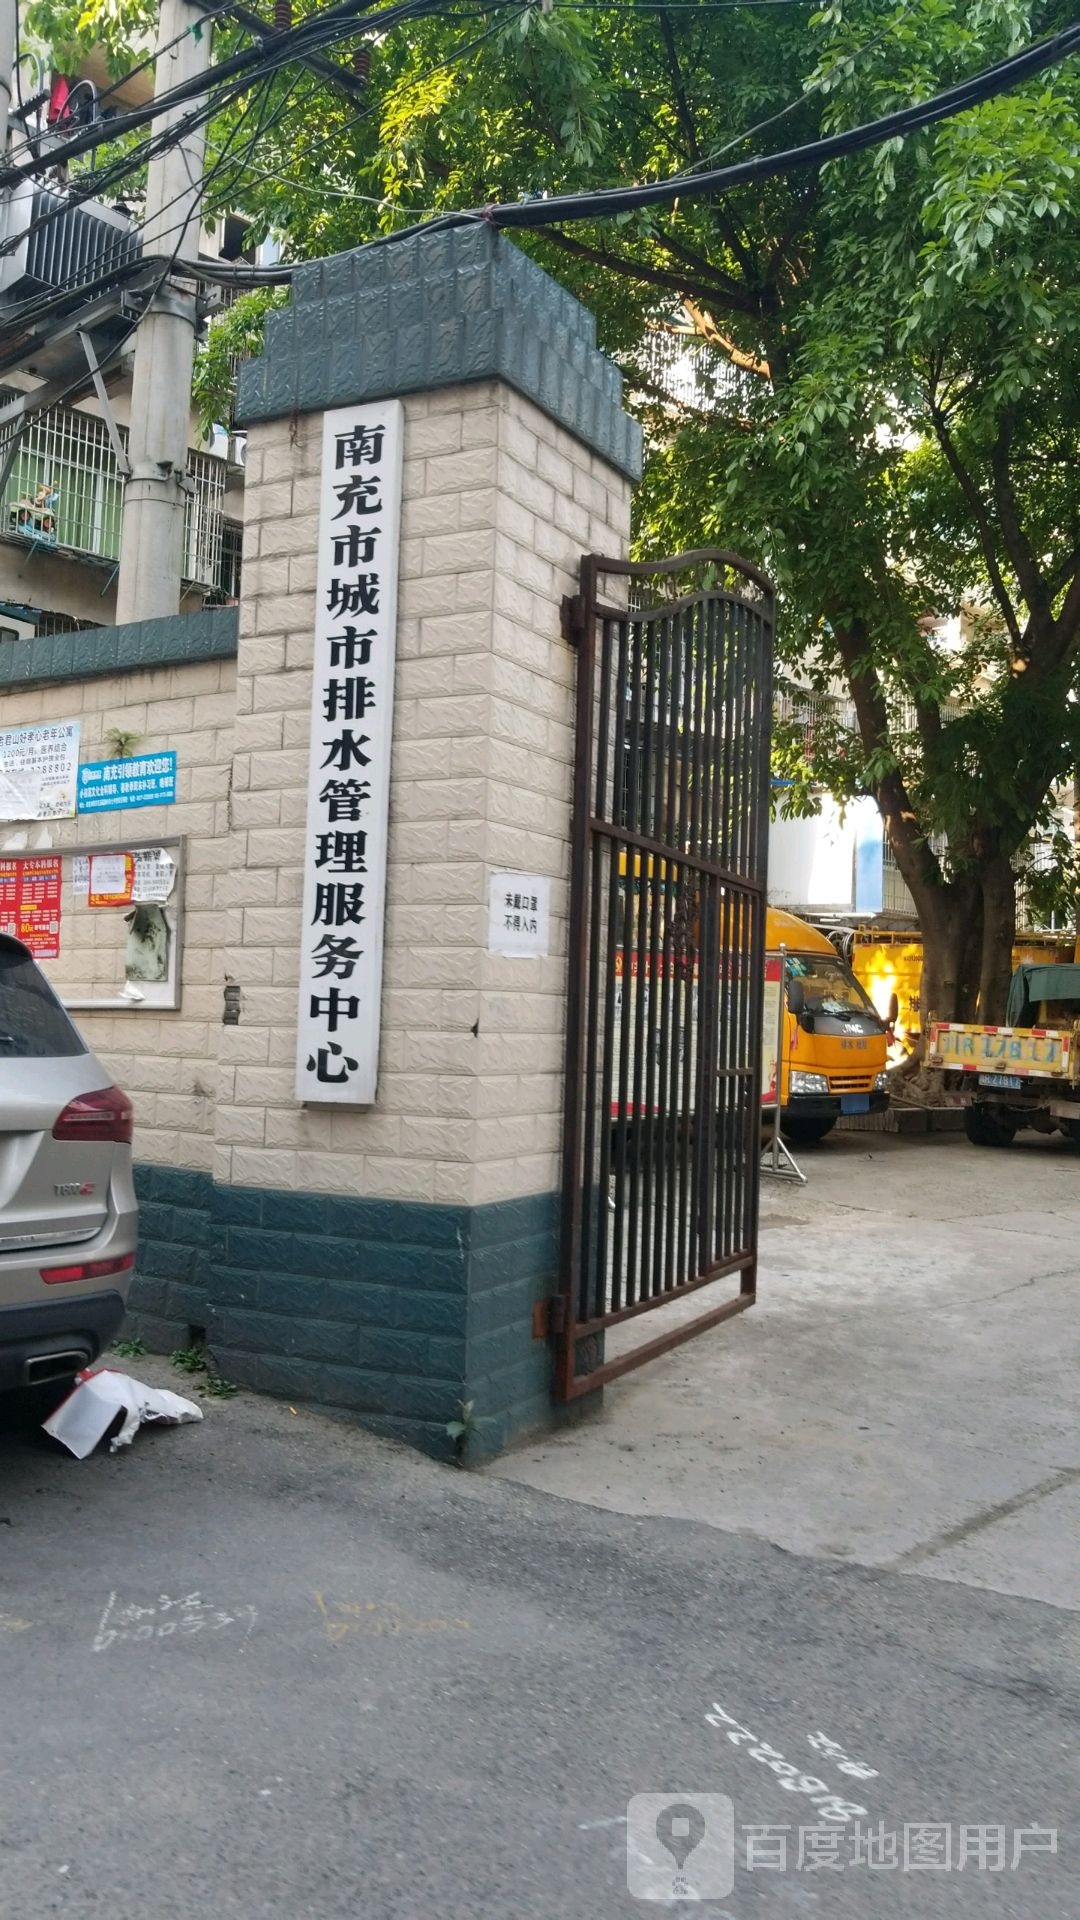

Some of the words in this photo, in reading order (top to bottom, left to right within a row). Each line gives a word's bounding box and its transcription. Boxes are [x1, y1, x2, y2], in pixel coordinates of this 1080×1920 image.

[306, 424, 386, 1084] 南充市城市排水管理服务中心
[504, 914, 537, 934] 不得入内
[842, 1023, 864, 1034] JMC
